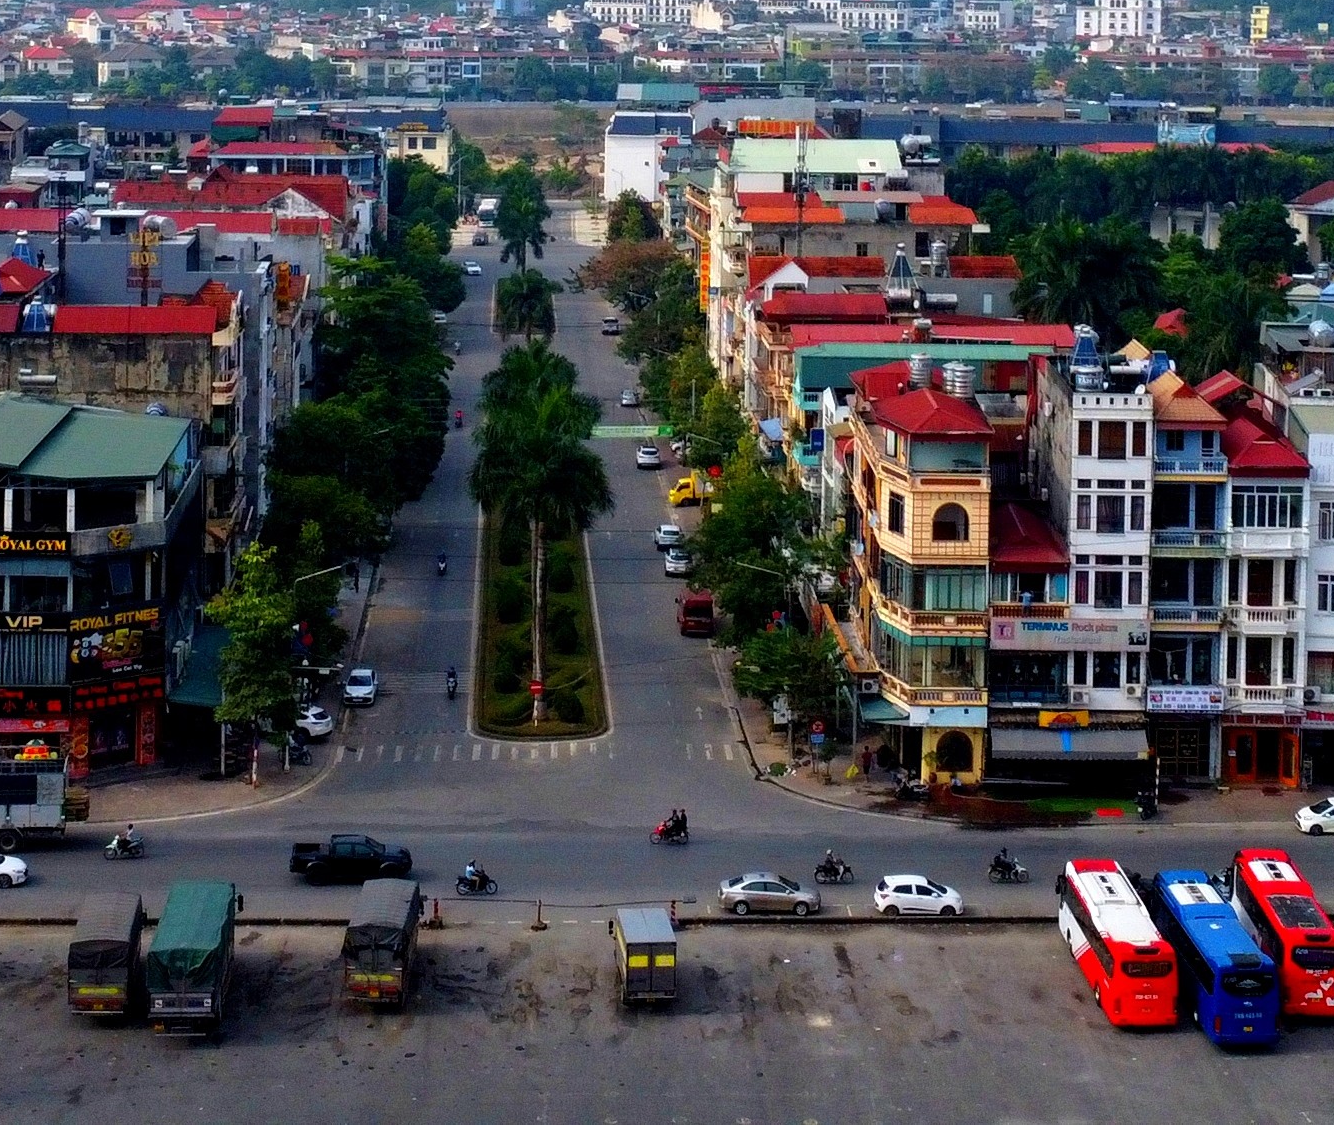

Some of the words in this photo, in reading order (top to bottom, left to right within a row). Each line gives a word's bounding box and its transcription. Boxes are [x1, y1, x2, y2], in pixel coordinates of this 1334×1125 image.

[35, 539, 67, 551] GYM
[5, 615, 44, 628] VIP
[69, 615, 112, 632] ROYAL
[114, 607, 160, 625] FITNES
[1021, 622, 1069, 632] TERMINUS
[1071, 623, 1095, 632] Rock
